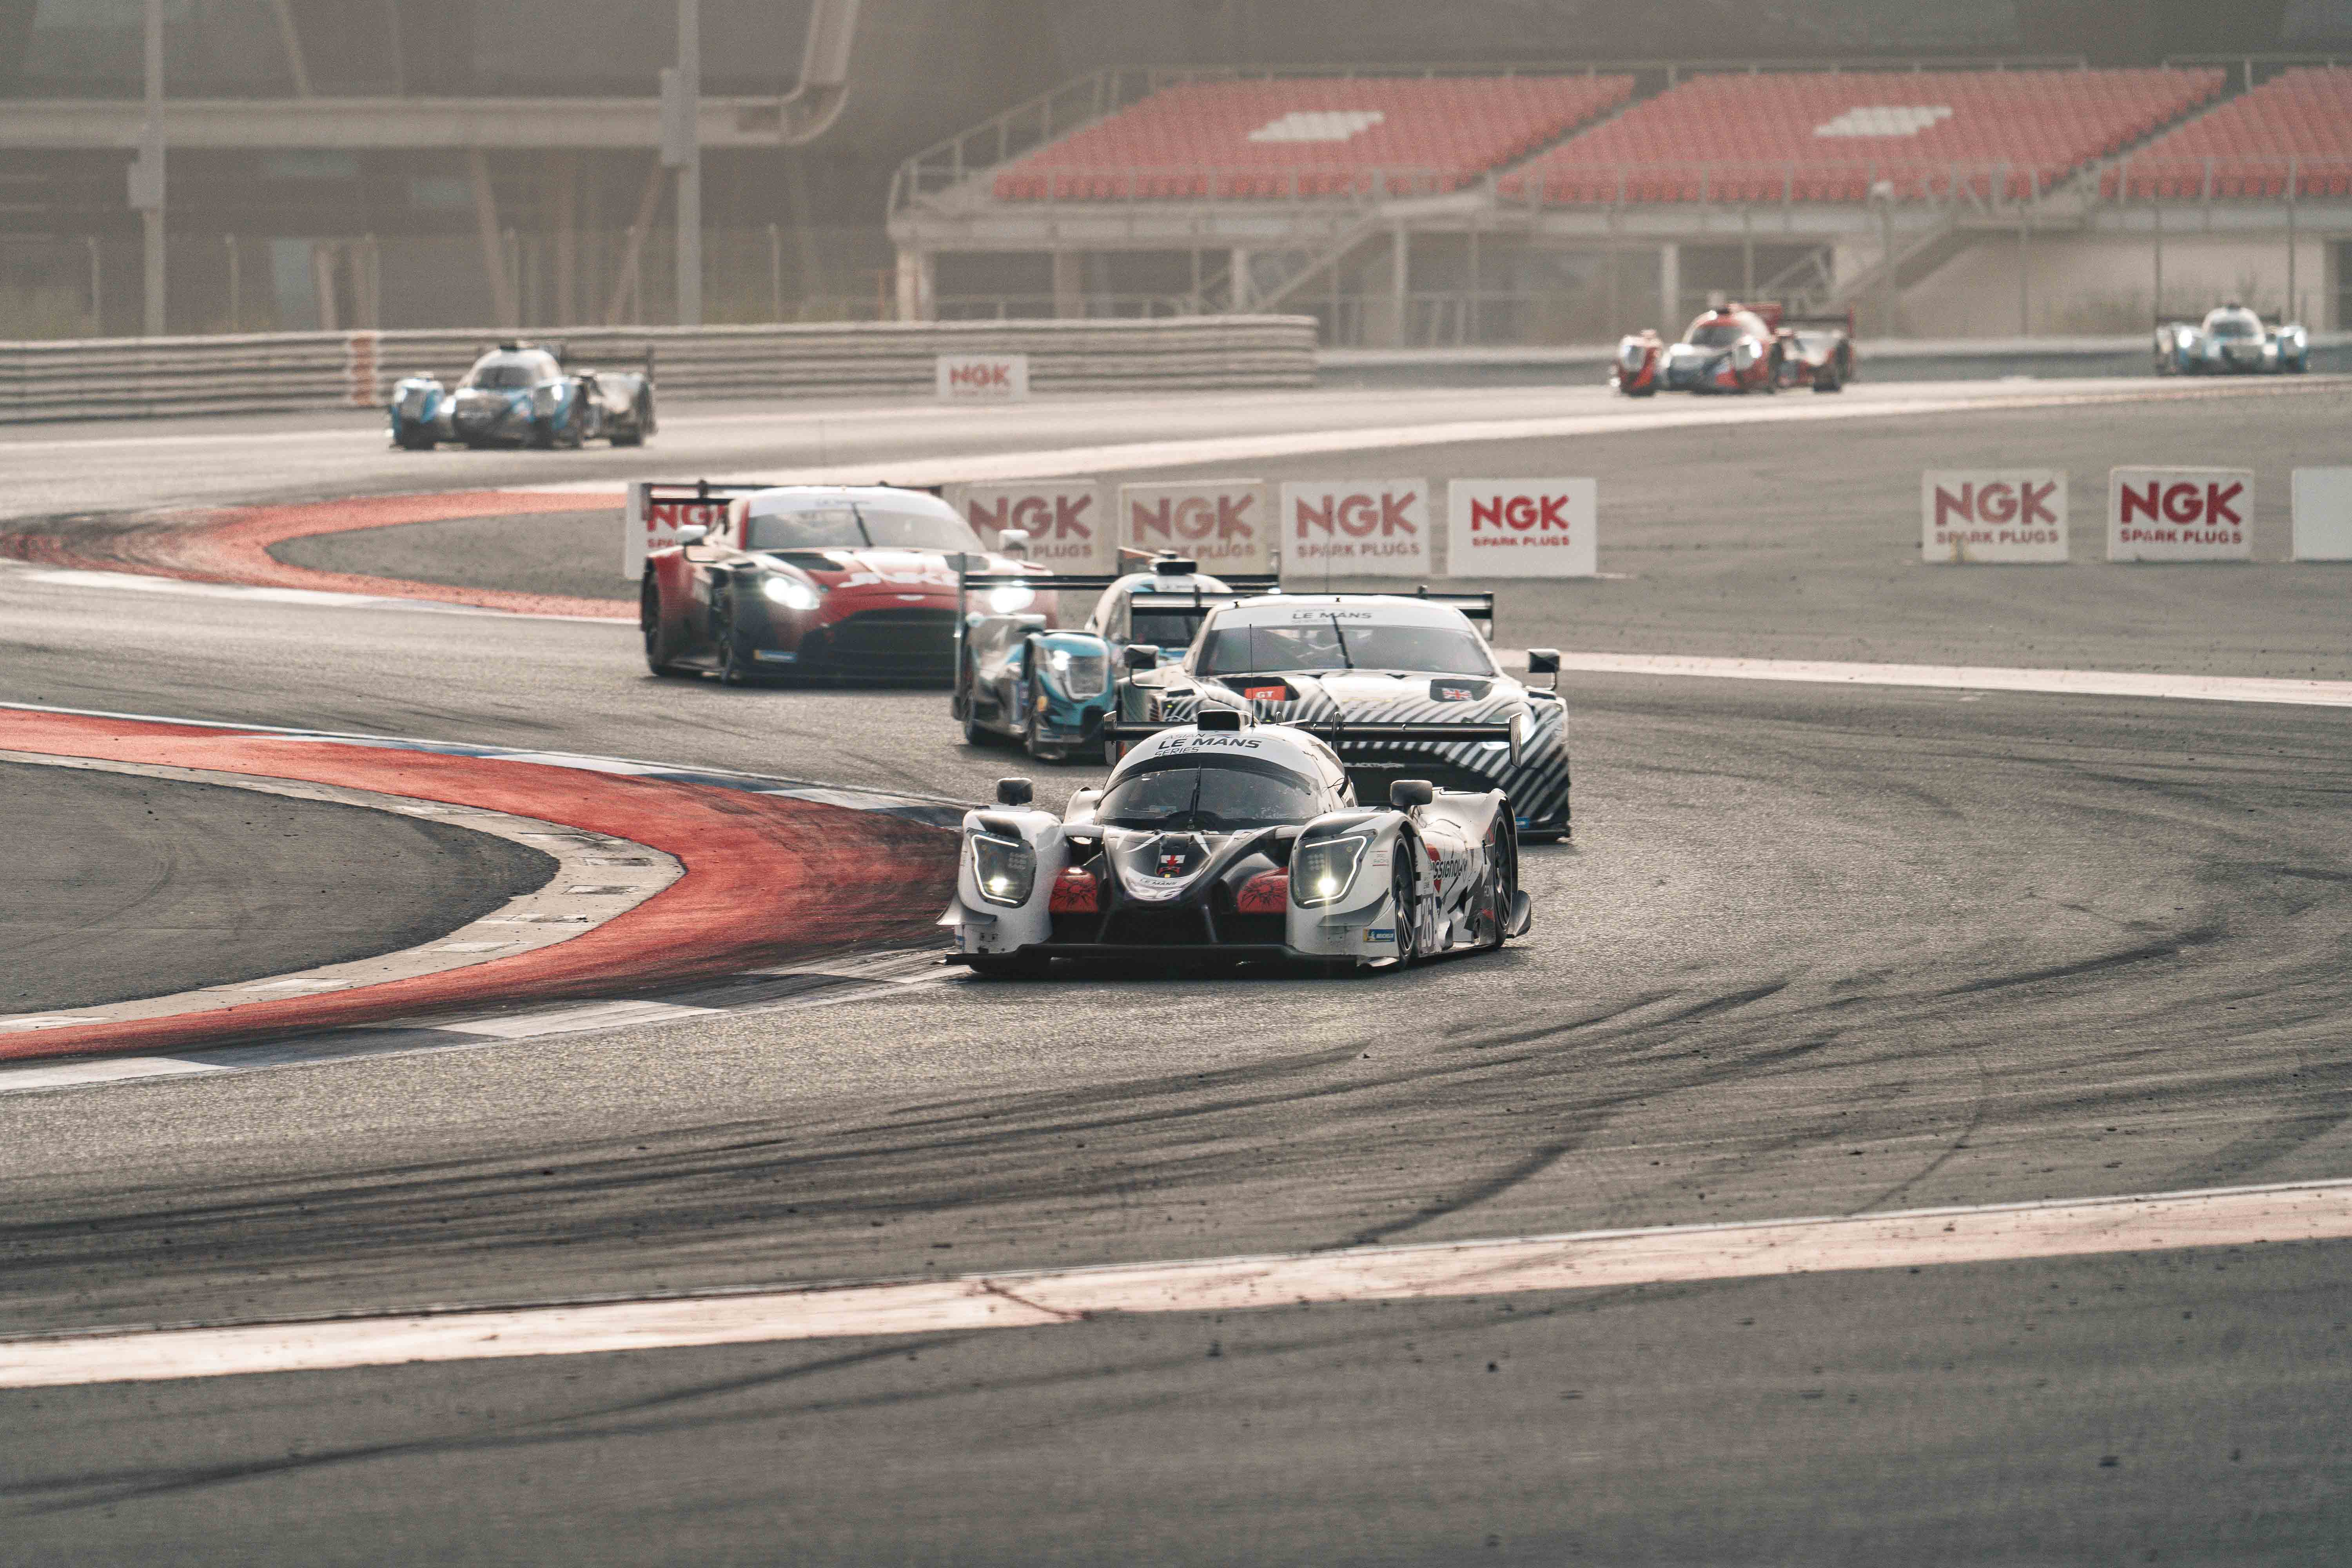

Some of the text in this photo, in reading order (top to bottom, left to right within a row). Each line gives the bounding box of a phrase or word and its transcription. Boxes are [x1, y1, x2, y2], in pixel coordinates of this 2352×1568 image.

[1472, 495, 1570, 531] NGK
[1935, 481, 2056, 525] NGK
[2121, 482, 2243, 524] NGK
[647, 505, 727, 532] NG
[969, 494, 1093, 539] NGK
[1132, 495, 1254, 541] NGK
[1296, 491, 1417, 538] NGK
[1472, 535, 1571, 546] SPARK PLUGS
[1936, 530, 2058, 544] SPARK PLUGS
[2121, 529, 2242, 543] SPARK PLUGS
[1033, 545, 1092, 557] PLUGS
[1298, 543, 1420, 557] SPARK PLUGS
[1154, 746, 1200, 758] SERIES
[1158, 738, 1262, 750] LE MANS
